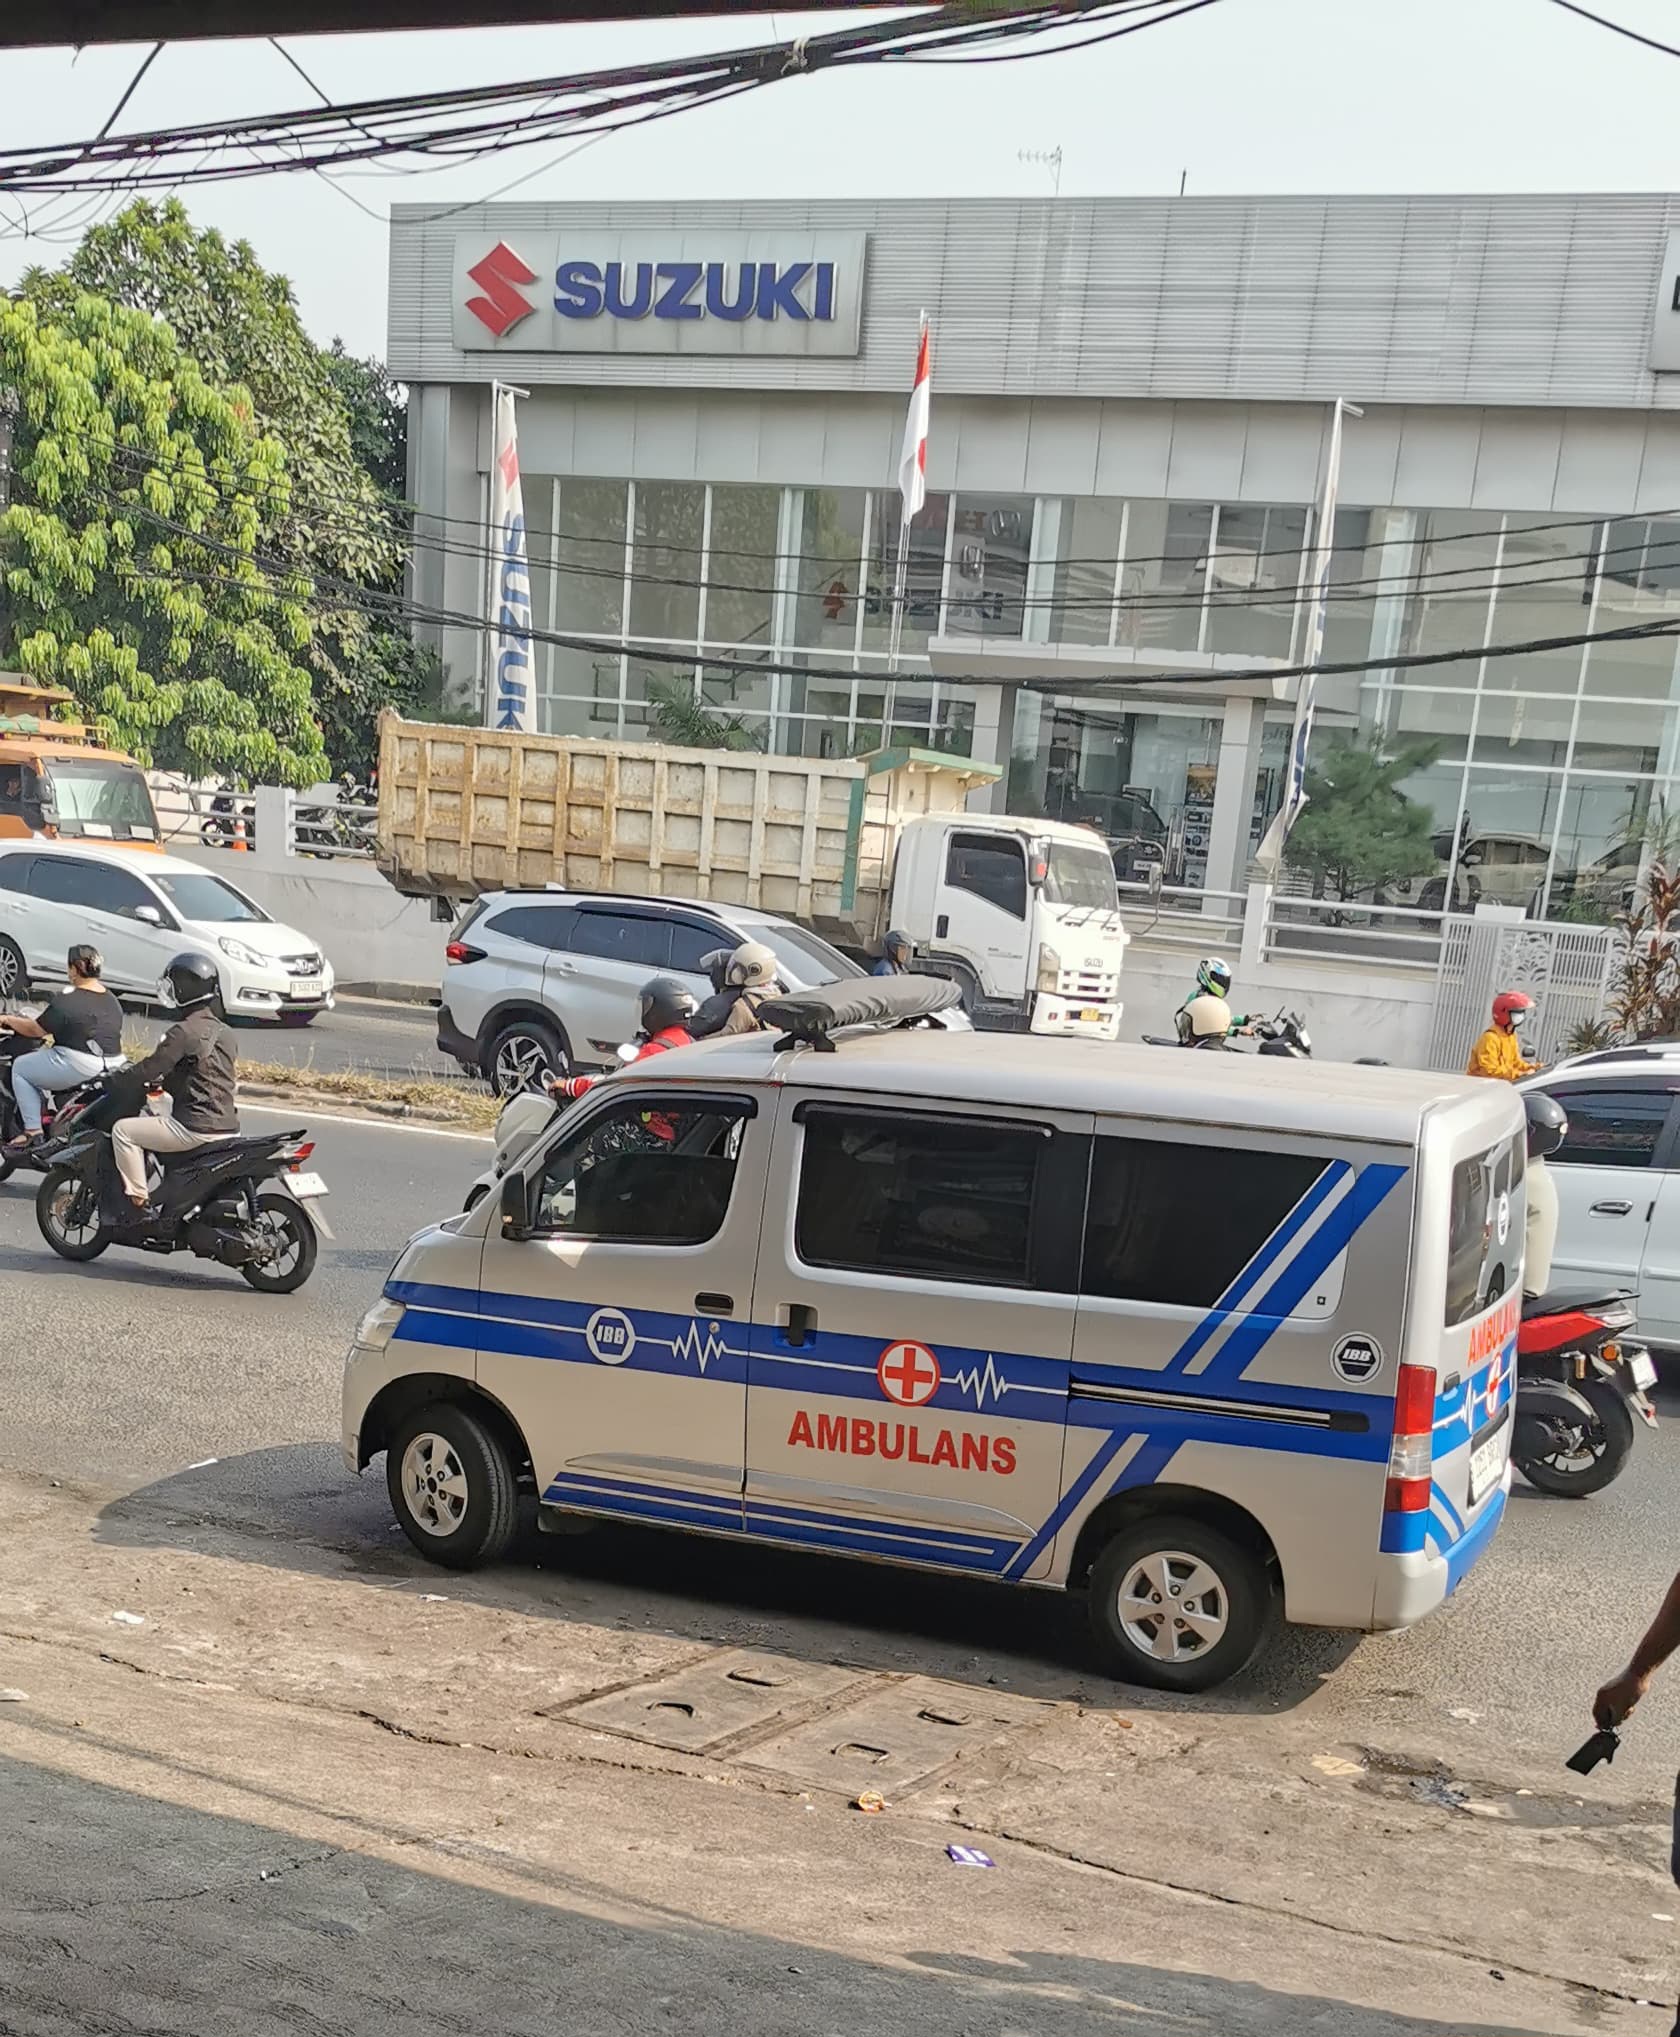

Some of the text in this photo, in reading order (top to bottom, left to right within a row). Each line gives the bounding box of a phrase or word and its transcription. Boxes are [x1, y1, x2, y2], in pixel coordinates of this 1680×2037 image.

[554, 261, 838, 322] SUZUKI
[496, 509, 530, 731] SUZUK
[596, 1324, 626, 1345] IBB
[1342, 1348, 1372, 1362] IBB
[787, 1410, 1018, 1475] AMBULANS
